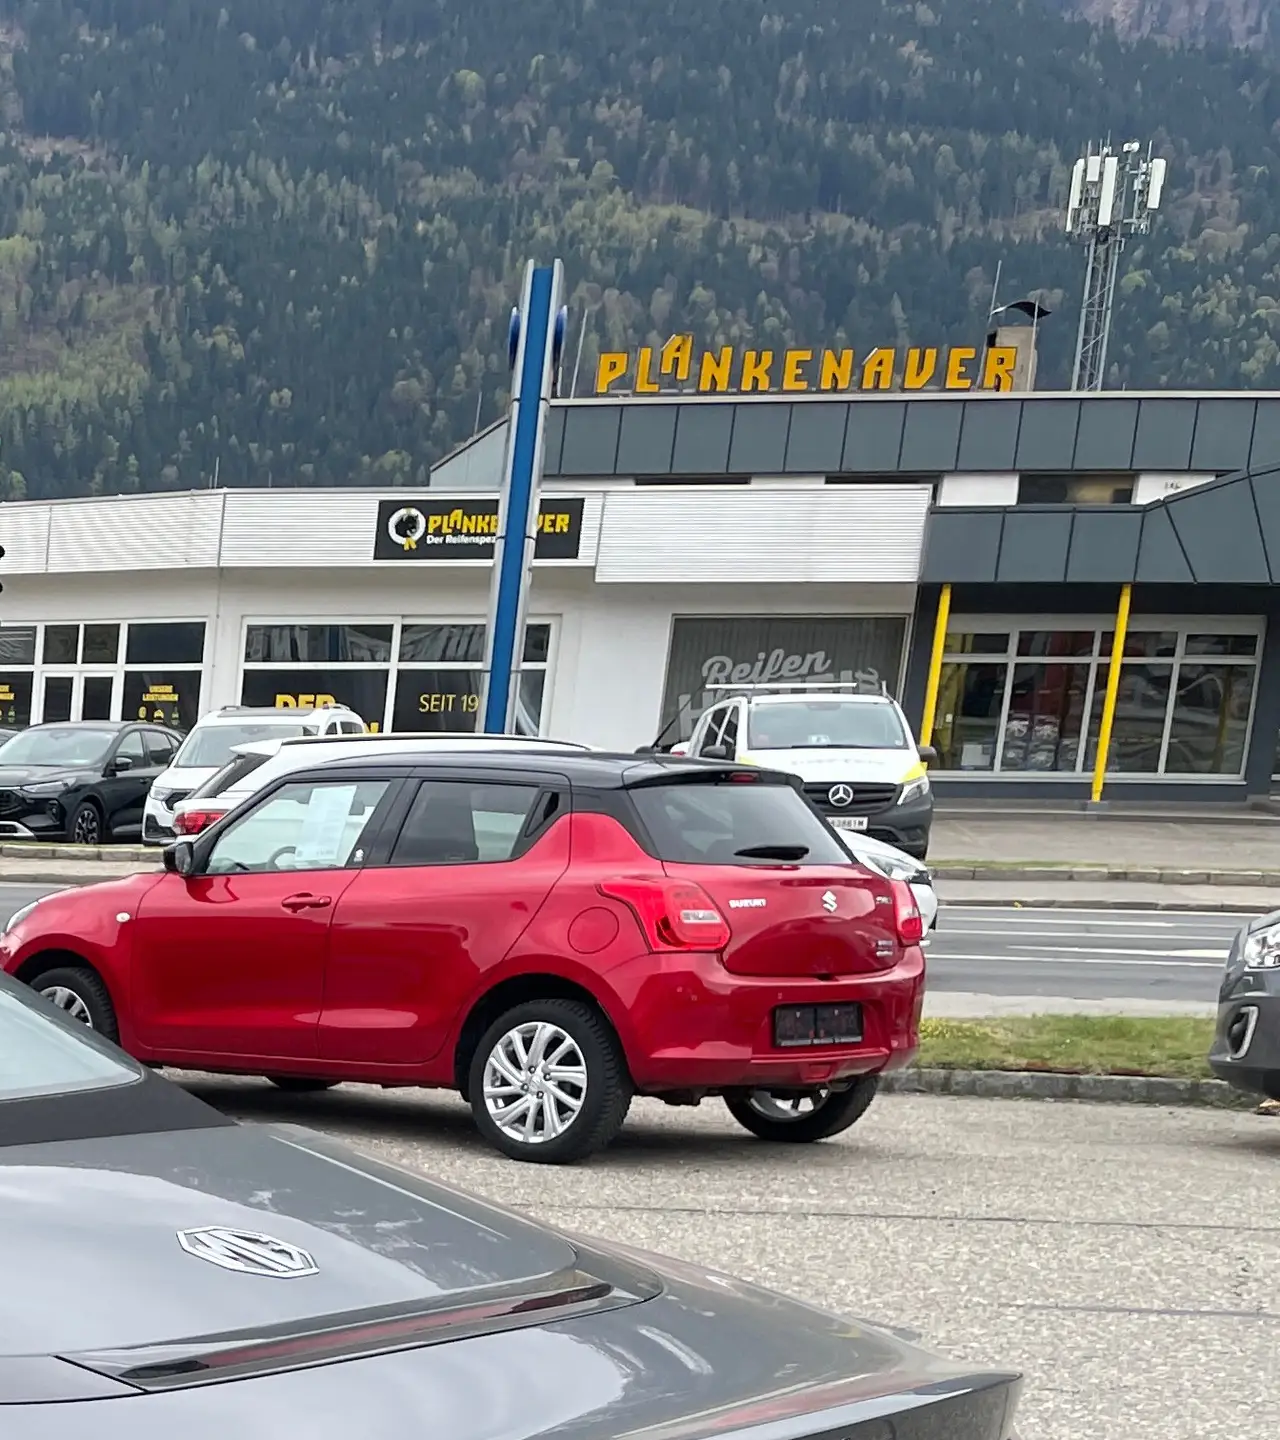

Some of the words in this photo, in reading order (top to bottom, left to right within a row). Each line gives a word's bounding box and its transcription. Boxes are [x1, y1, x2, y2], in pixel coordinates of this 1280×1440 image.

[426, 535, 444, 545] Der
[701, 648, 832, 684] Reifen
[418, 693, 456, 714] SEIT
